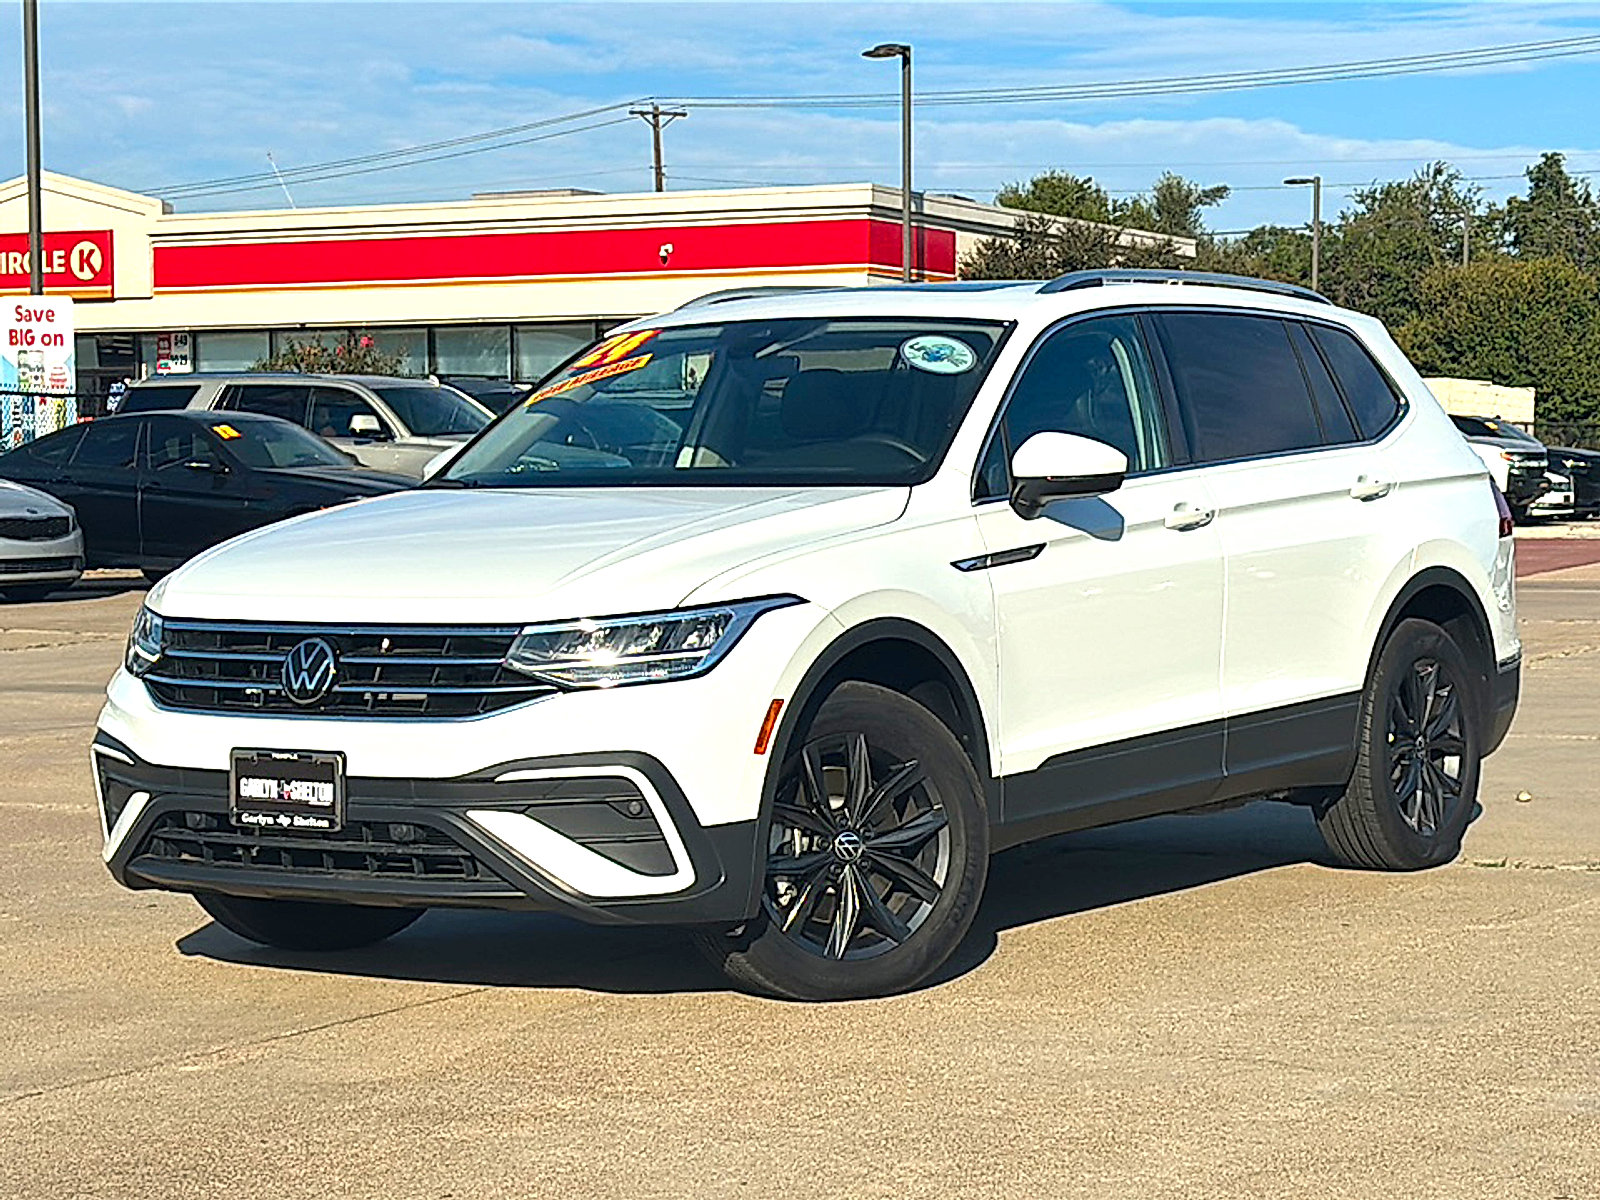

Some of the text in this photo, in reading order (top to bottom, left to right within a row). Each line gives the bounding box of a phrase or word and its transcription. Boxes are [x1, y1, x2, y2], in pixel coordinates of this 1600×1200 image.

[76, 246, 100, 278] K
[15, 304, 55, 322] Save
[9, 328, 64, 346] BIG on
[285, 639, 333, 697] VW
